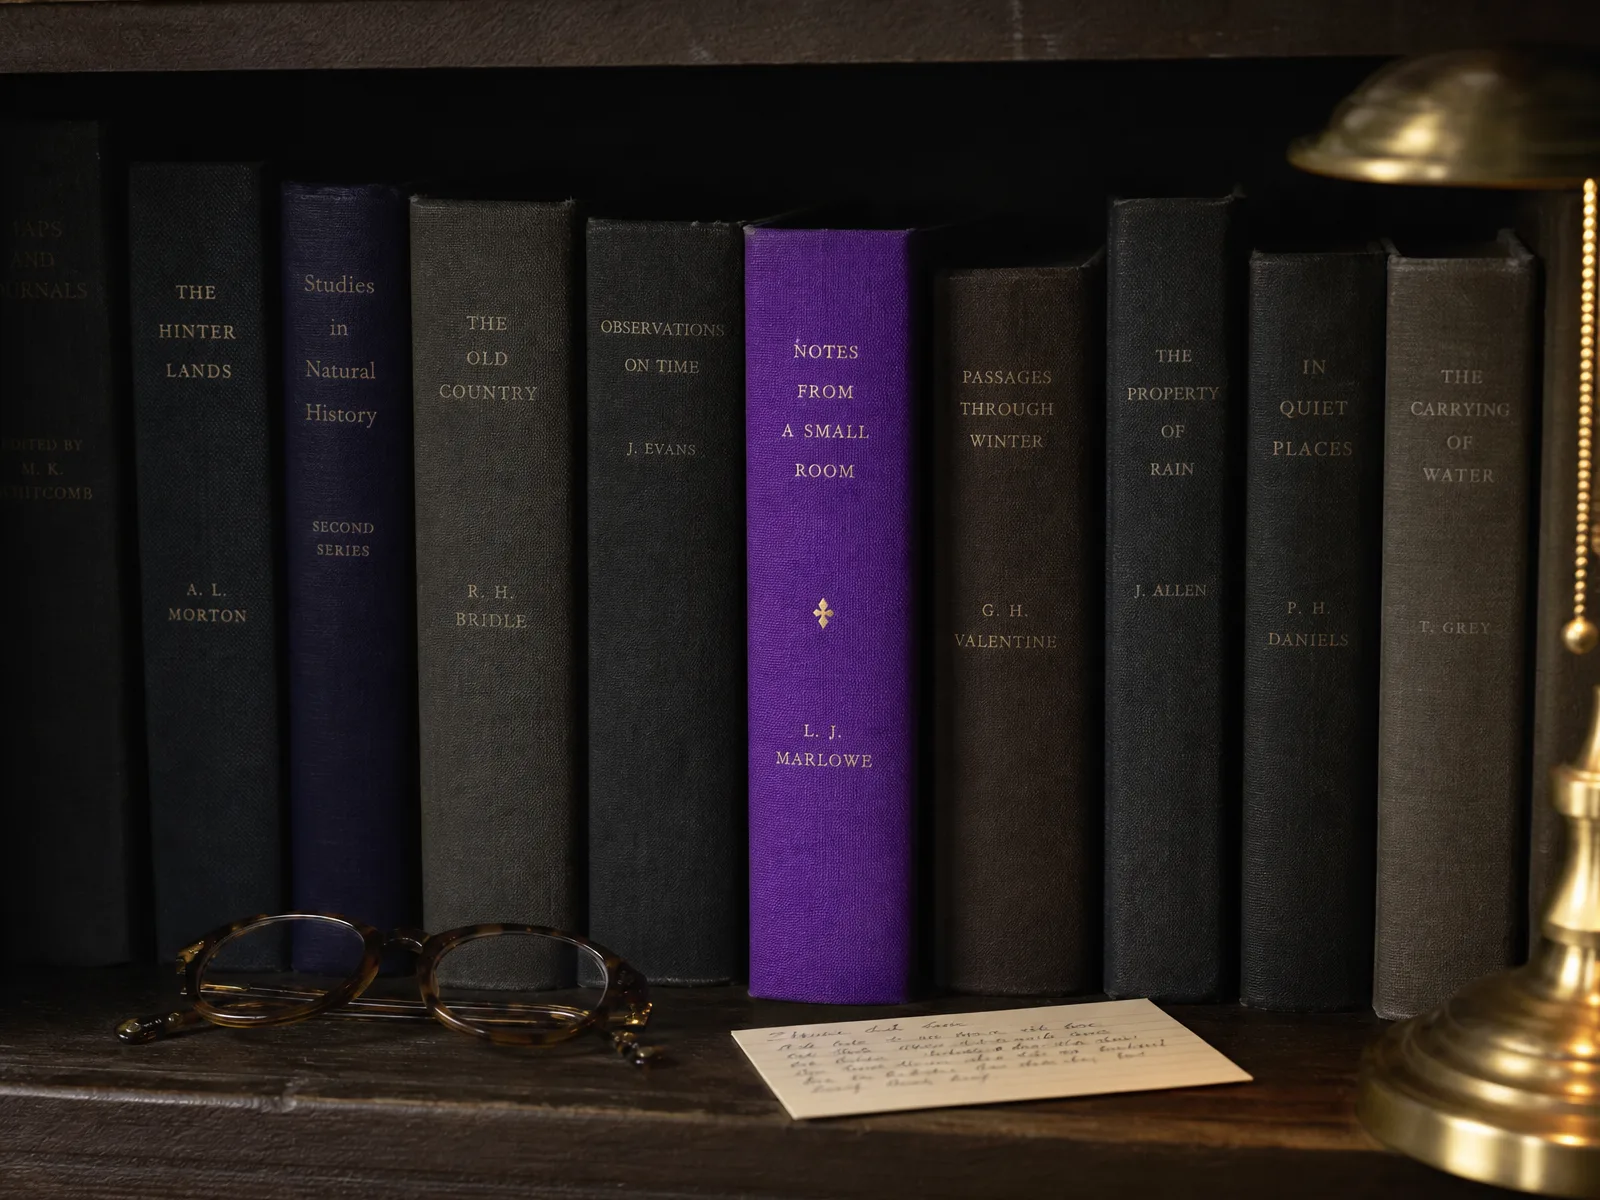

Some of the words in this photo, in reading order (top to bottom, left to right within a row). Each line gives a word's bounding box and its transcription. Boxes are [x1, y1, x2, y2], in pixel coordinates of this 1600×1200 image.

[9, 250, 55, 268] AND
[175, 284, 217, 300] THE
[303, 273, 376, 295] Studies
[330, 320, 348, 336] in
[465, 313, 508, 332] THE
[600, 319, 725, 337] OBSERVATIONS
[158, 323, 237, 340] HINTER
[465, 350, 509, 367] OLD
[793, 343, 859, 360] NOTES
[1155, 348, 1193, 363] THE
[166, 362, 232, 379] LANDS
[305, 359, 377, 380] Natural
[624, 357, 650, 373] ON
[655, 358, 700, 375] TIME
[1302, 359, 1327, 375] IN
[962, 369, 1052, 385] PASSAGES
[1440, 368, 1483, 385] THE
[438, 383, 538, 402] COUNTRY
[797, 383, 854, 400] FROM
[1127, 386, 1220, 402] PROPERTY
[305, 402, 378, 429] History
[959, 401, 1054, 417] THROUGH
[1279, 399, 1349, 419] QUIET
[1409, 400, 1510, 417] CARRYING
[781, 423, 795, 438] A
[803, 423, 870, 440] SMALL
[1160, 423, 1186, 439] OF
[63, 438, 84, 451] BY
[626, 441, 638, 457] J.
[644, 441, 696, 456] EVANS
[969, 433, 1044, 449] WINTER
[1272, 440, 1353, 457] PLACES
[1446, 434, 1474, 451] OF
[47, 461, 65, 475] K.
[794, 462, 855, 479] ROOM
[1150, 462, 1195, 477] RAIN
[1422, 467, 1495, 483] WATER
[311, 520, 375, 535] SECOND
[316, 543, 370, 558] SERIES
[186, 582, 203, 597] A.
[211, 582, 227, 598] L.
[467, 583, 485, 599] R.
[494, 584, 515, 600] H.
[1133, 583, 1146, 600] J.
[1151, 583, 1207, 597] ALLEN
[168, 607, 247, 624] MORTON
[983, 604, 999, 617] G.
[1009, 603, 1029, 618] H.
[1288, 602, 1303, 615] P.
[1311, 602, 1331, 615] H.
[455, 611, 528, 630] BRIDLE
[1418, 620, 1436, 635] T.
[1441, 621, 1491, 635] GREY
[954, 633, 1057, 649] VALENTINE
[1267, 631, 1349, 647] DANIELS
[803, 723, 820, 738] L.
[828, 724, 842, 741] J.
[775, 750, 873, 769] MARLOWE
